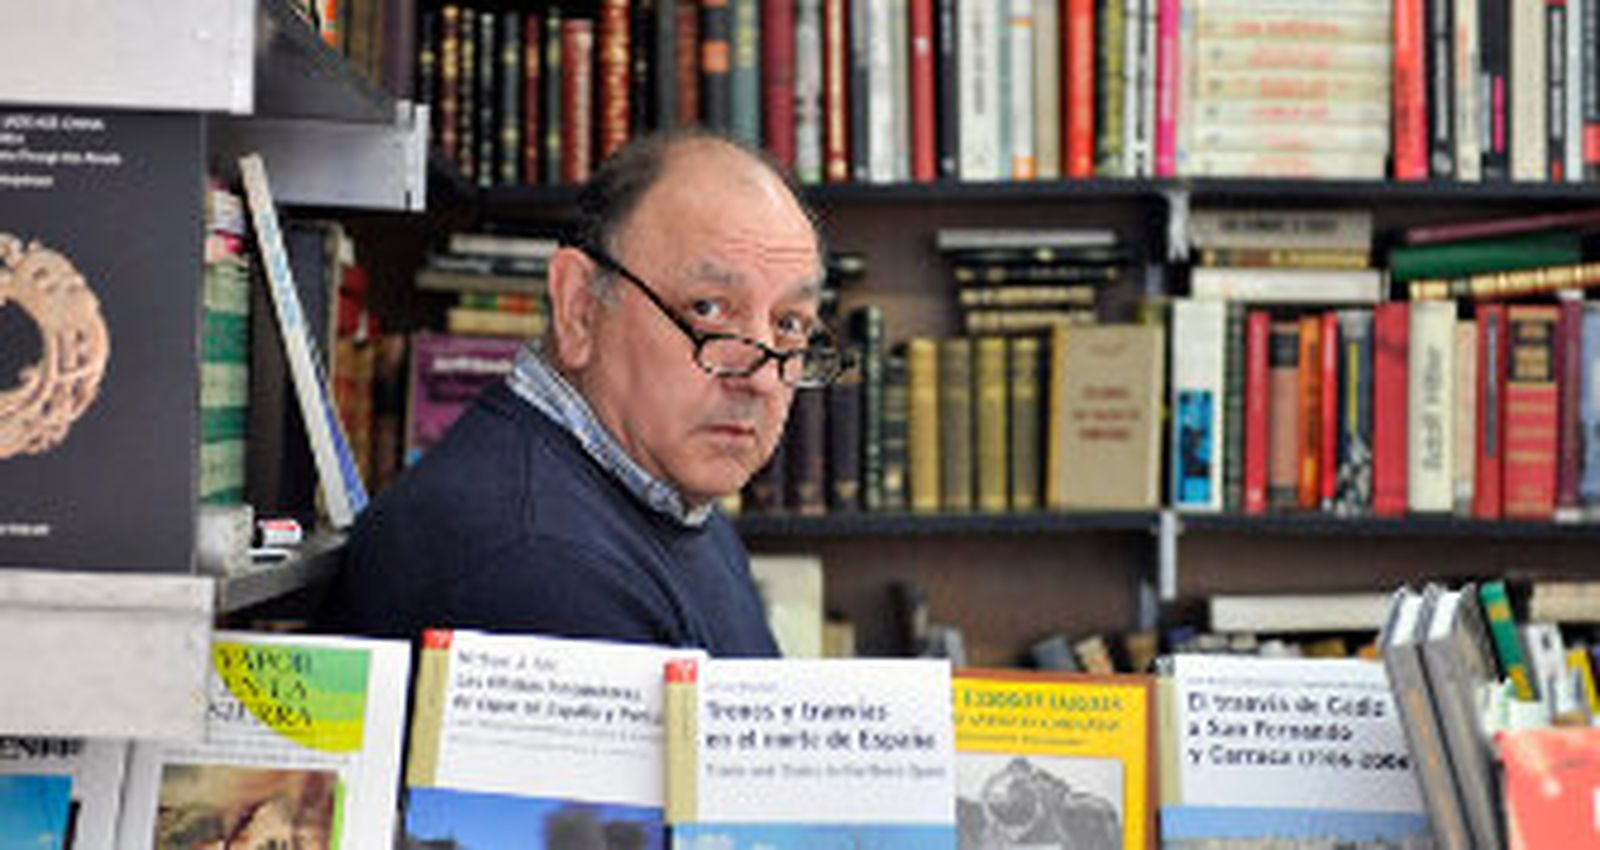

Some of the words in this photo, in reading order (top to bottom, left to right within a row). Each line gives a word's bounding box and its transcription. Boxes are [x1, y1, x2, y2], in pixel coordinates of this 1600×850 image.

[706, 734, 731, 750] en
[738, 730, 756, 750] el
[826, 731, 850, 750] de
[1207, 719, 1248, 737] San
[1254, 721, 1353, 741] Fernando
